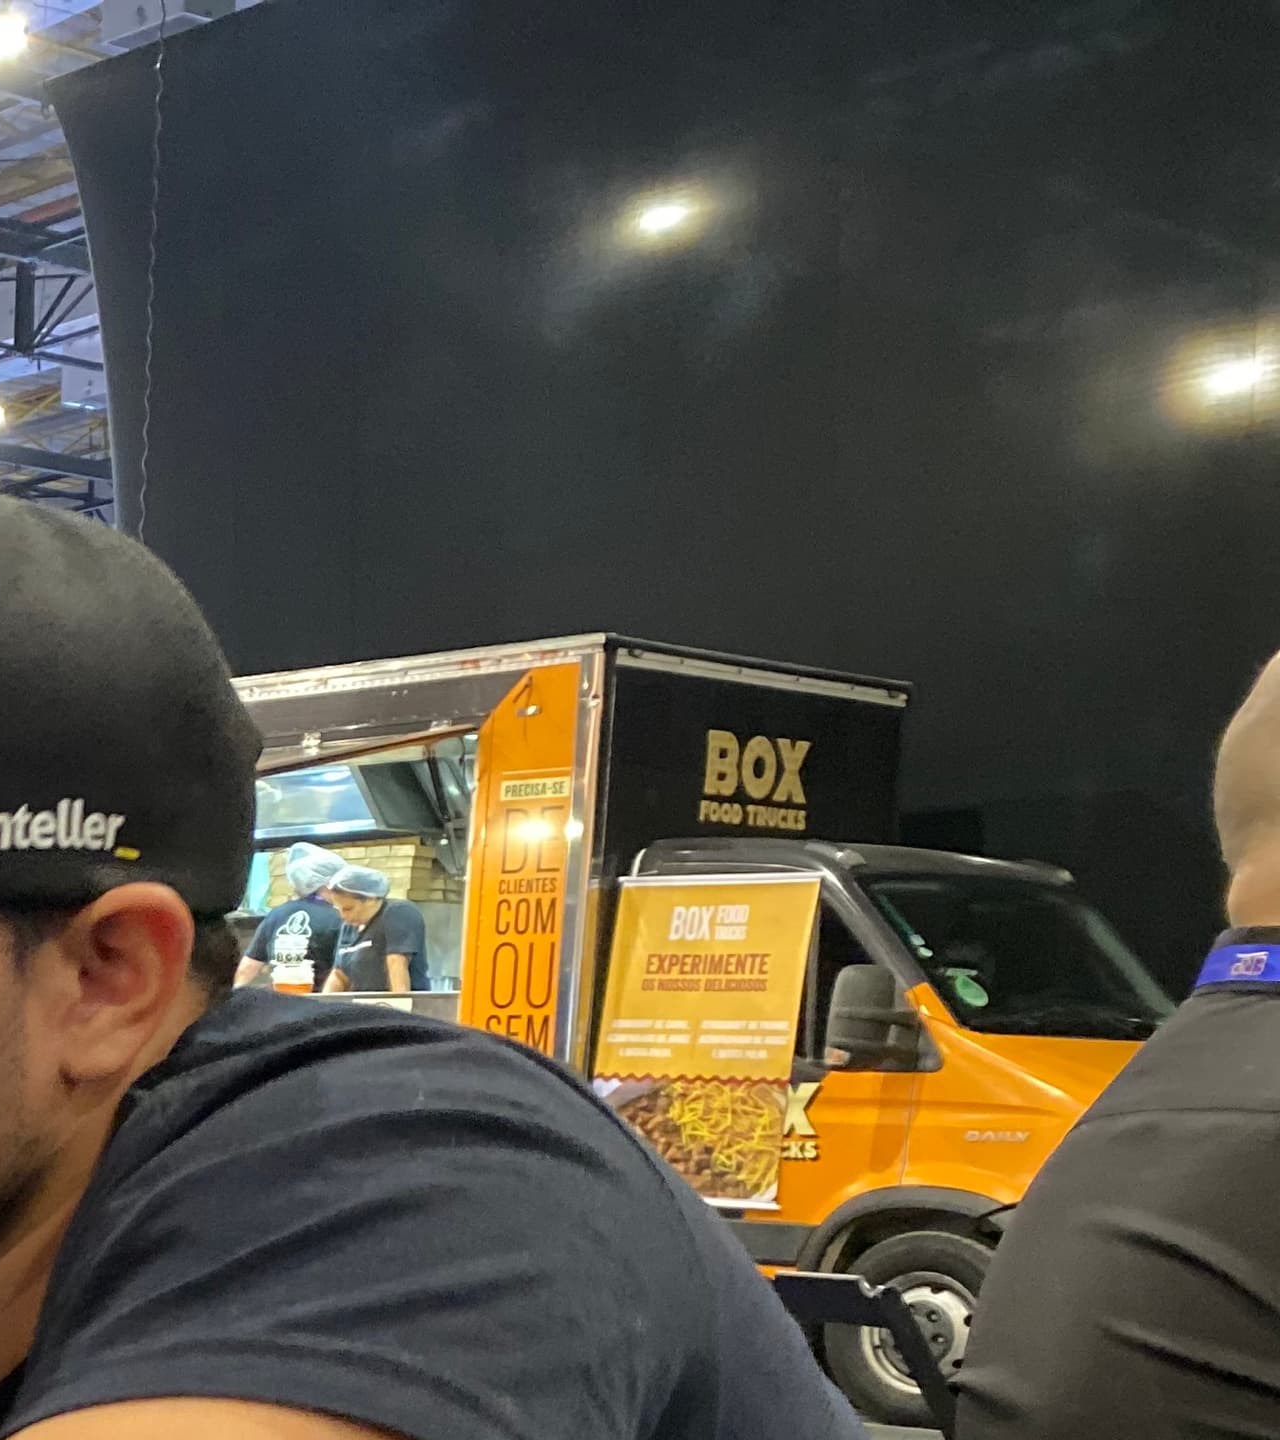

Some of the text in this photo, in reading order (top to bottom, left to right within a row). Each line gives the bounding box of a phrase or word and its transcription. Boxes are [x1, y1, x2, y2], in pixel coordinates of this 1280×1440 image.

[704, 729, 812, 804] BOX
[504, 781, 566, 798] PRECISA-SE
[699, 800, 807, 831] FOOD TRUCKS
[498, 877, 557, 895] CLIENTES
[495, 897, 557, 935] COM
[668, 905, 715, 941] BOX
[490, 941, 556, 1009] OU
[645, 953, 771, 975] EXPERIMENTE
[964, 1130, 1030, 1143] DAILY
